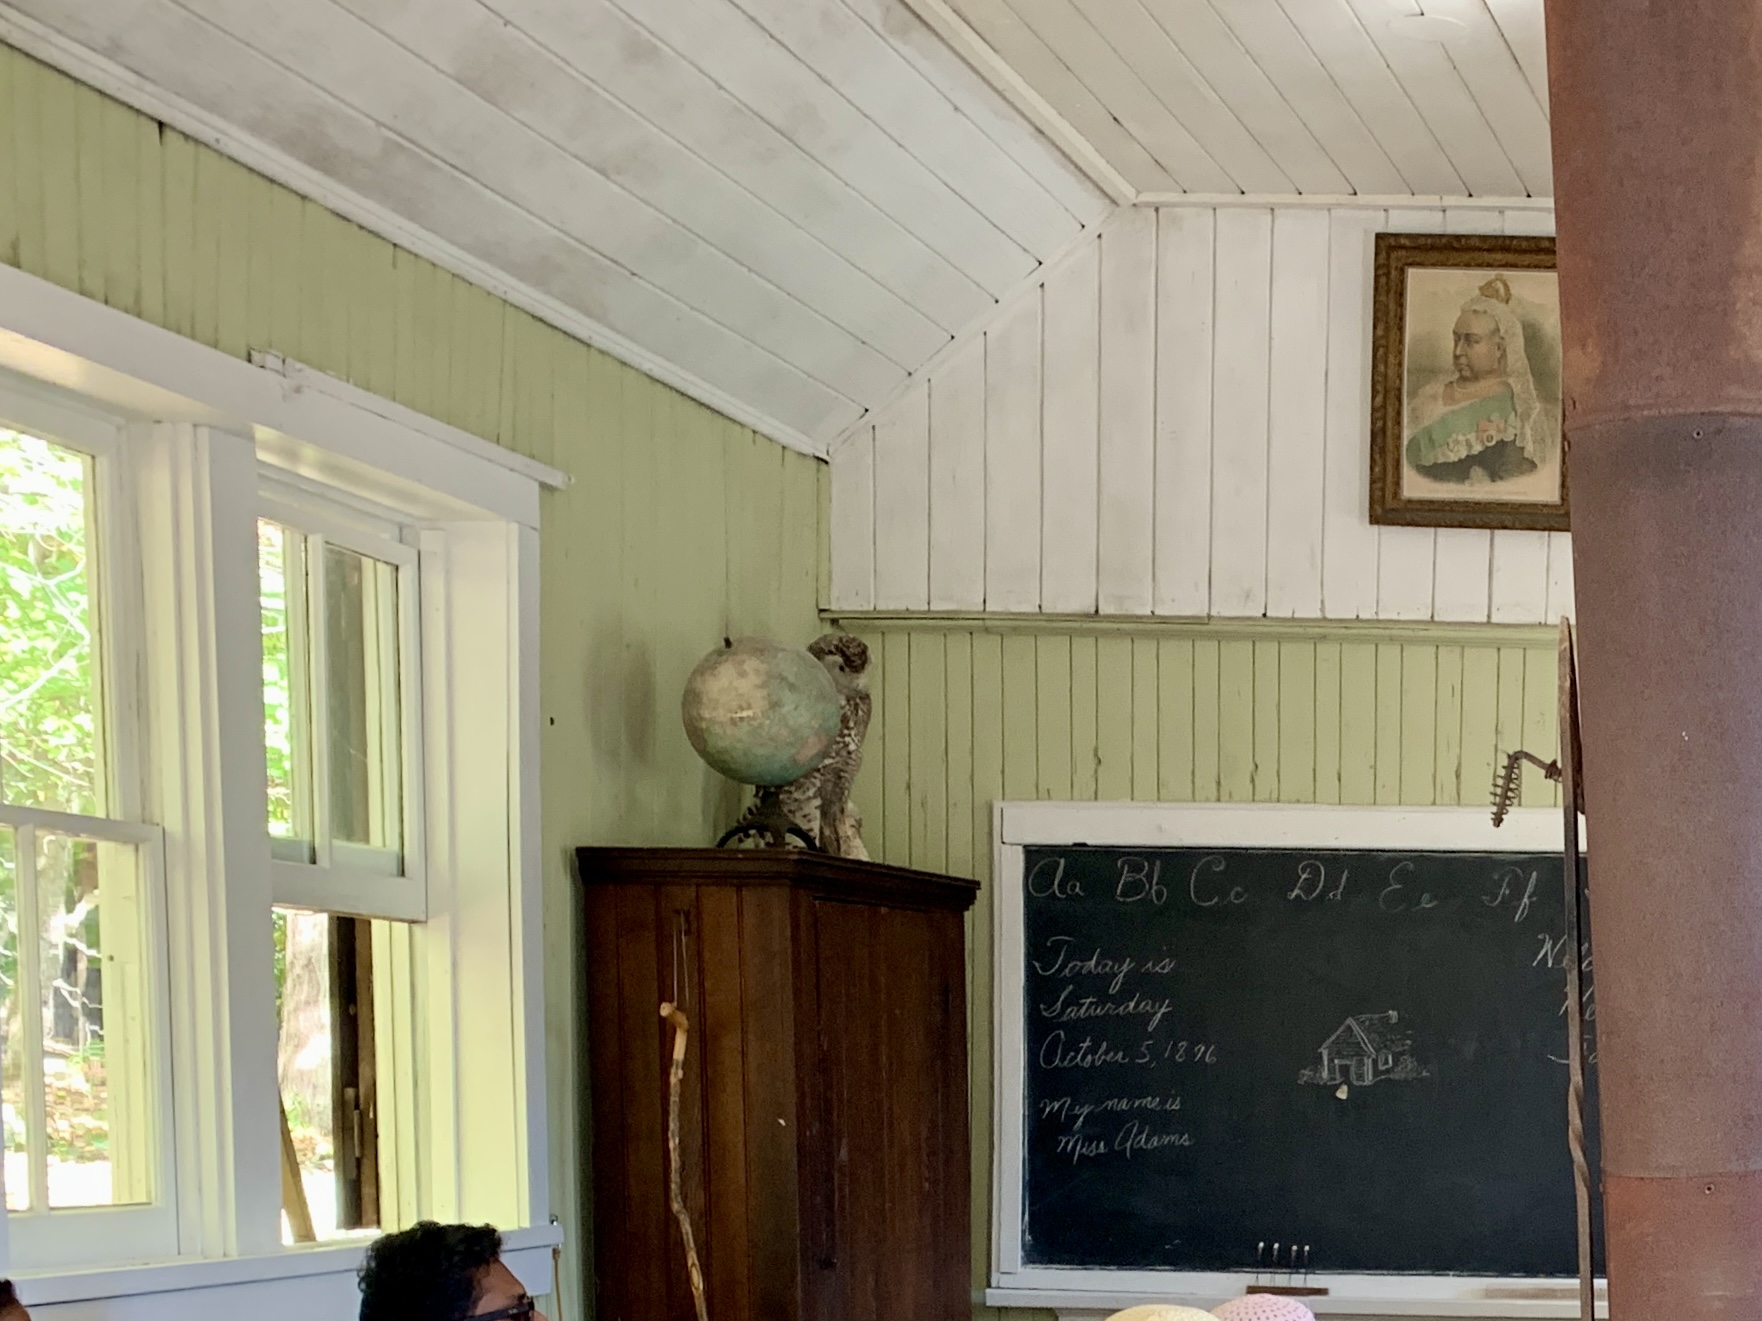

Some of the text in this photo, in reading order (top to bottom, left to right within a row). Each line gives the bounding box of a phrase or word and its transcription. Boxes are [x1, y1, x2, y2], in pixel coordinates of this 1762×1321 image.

[1033, 936, 1177, 995] Today is
[1040, 985, 1173, 1032] Saturday
[1040, 1029, 1129, 1069] October
[1040, 1089, 1182, 1131] My name is
[1057, 1120, 1194, 1165] Miss Adams
